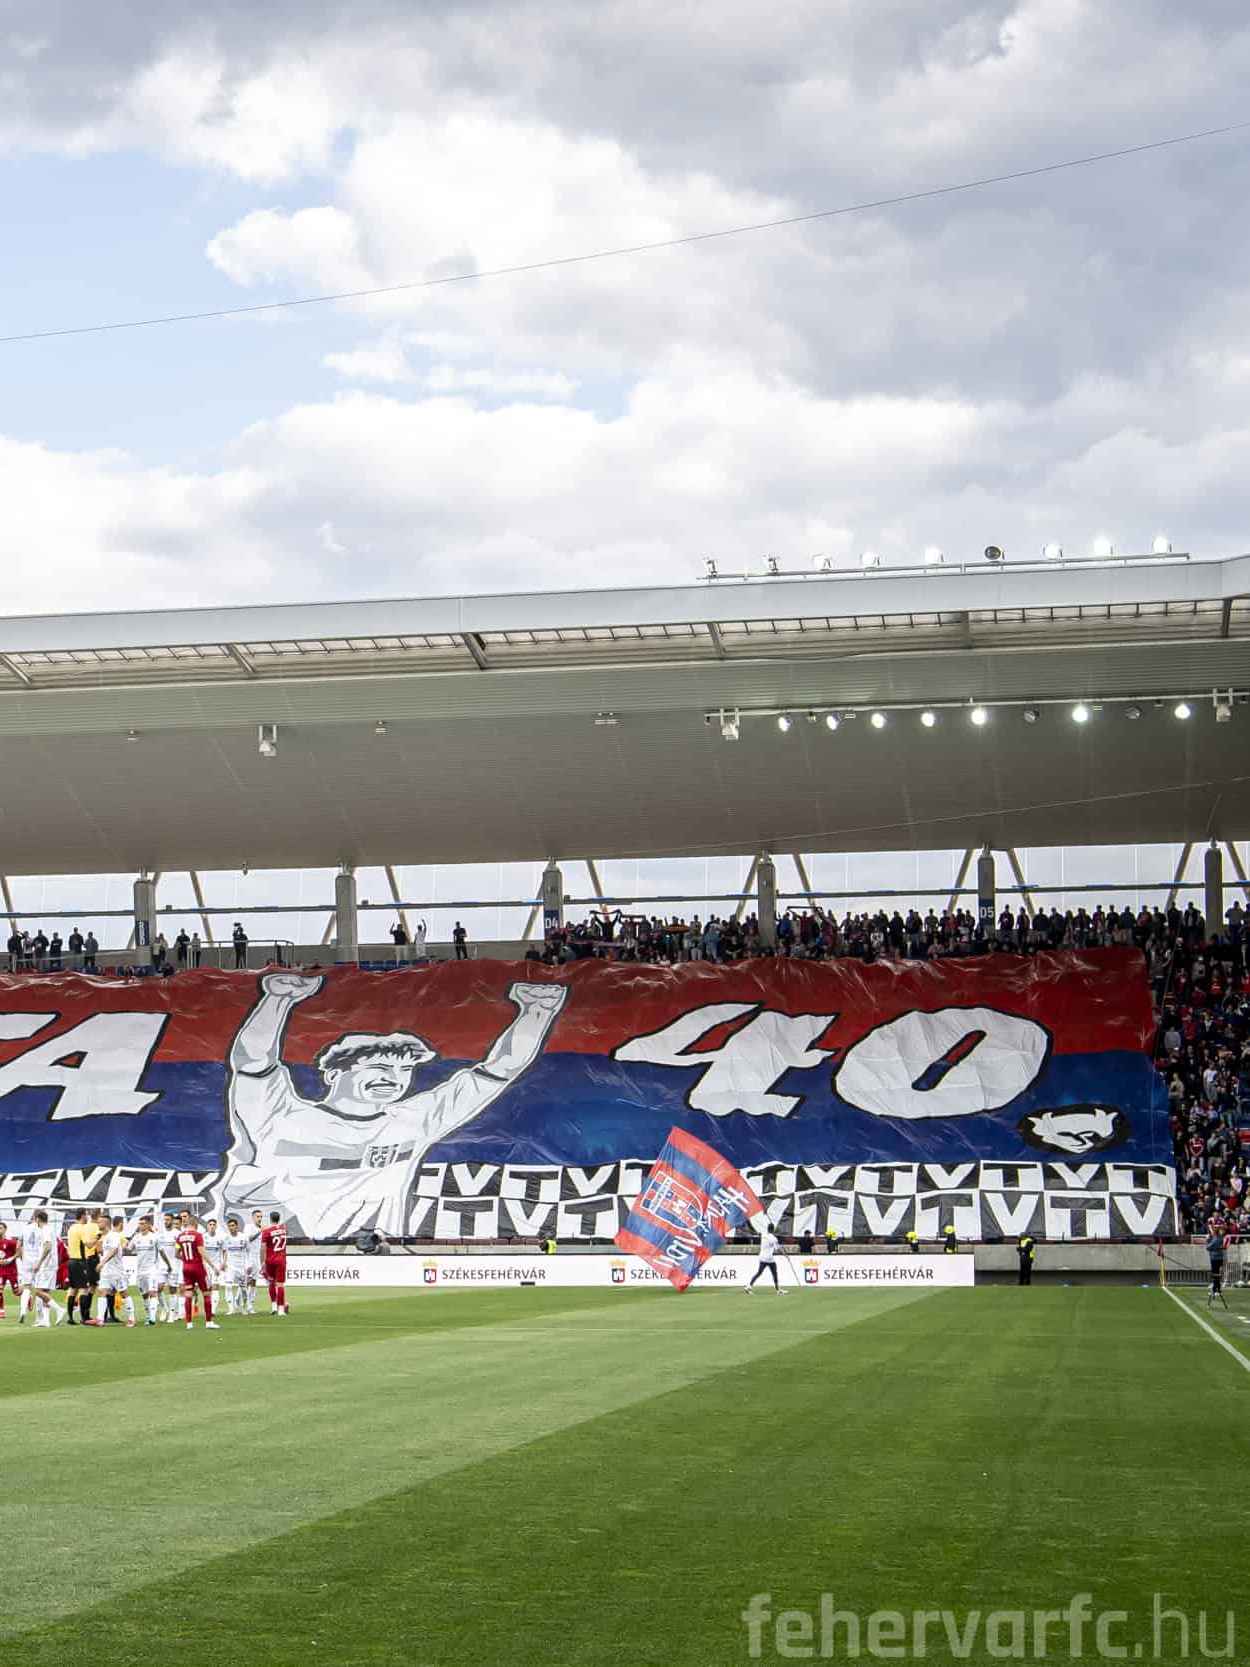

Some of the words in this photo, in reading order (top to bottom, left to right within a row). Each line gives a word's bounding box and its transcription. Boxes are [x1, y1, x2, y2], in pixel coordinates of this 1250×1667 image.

[980, 906, 994, 919] 05
[181, 1242, 194, 1261] 11
[272, 1236, 287, 1252] 27
[285, 1265, 360, 1280] ESFEHÉRVÁR
[441, 1265, 546, 1280] SZÉKESFEHÉRVÁR
[823, 1264, 934, 1280] SZÉKESFEHÉRVÁR
